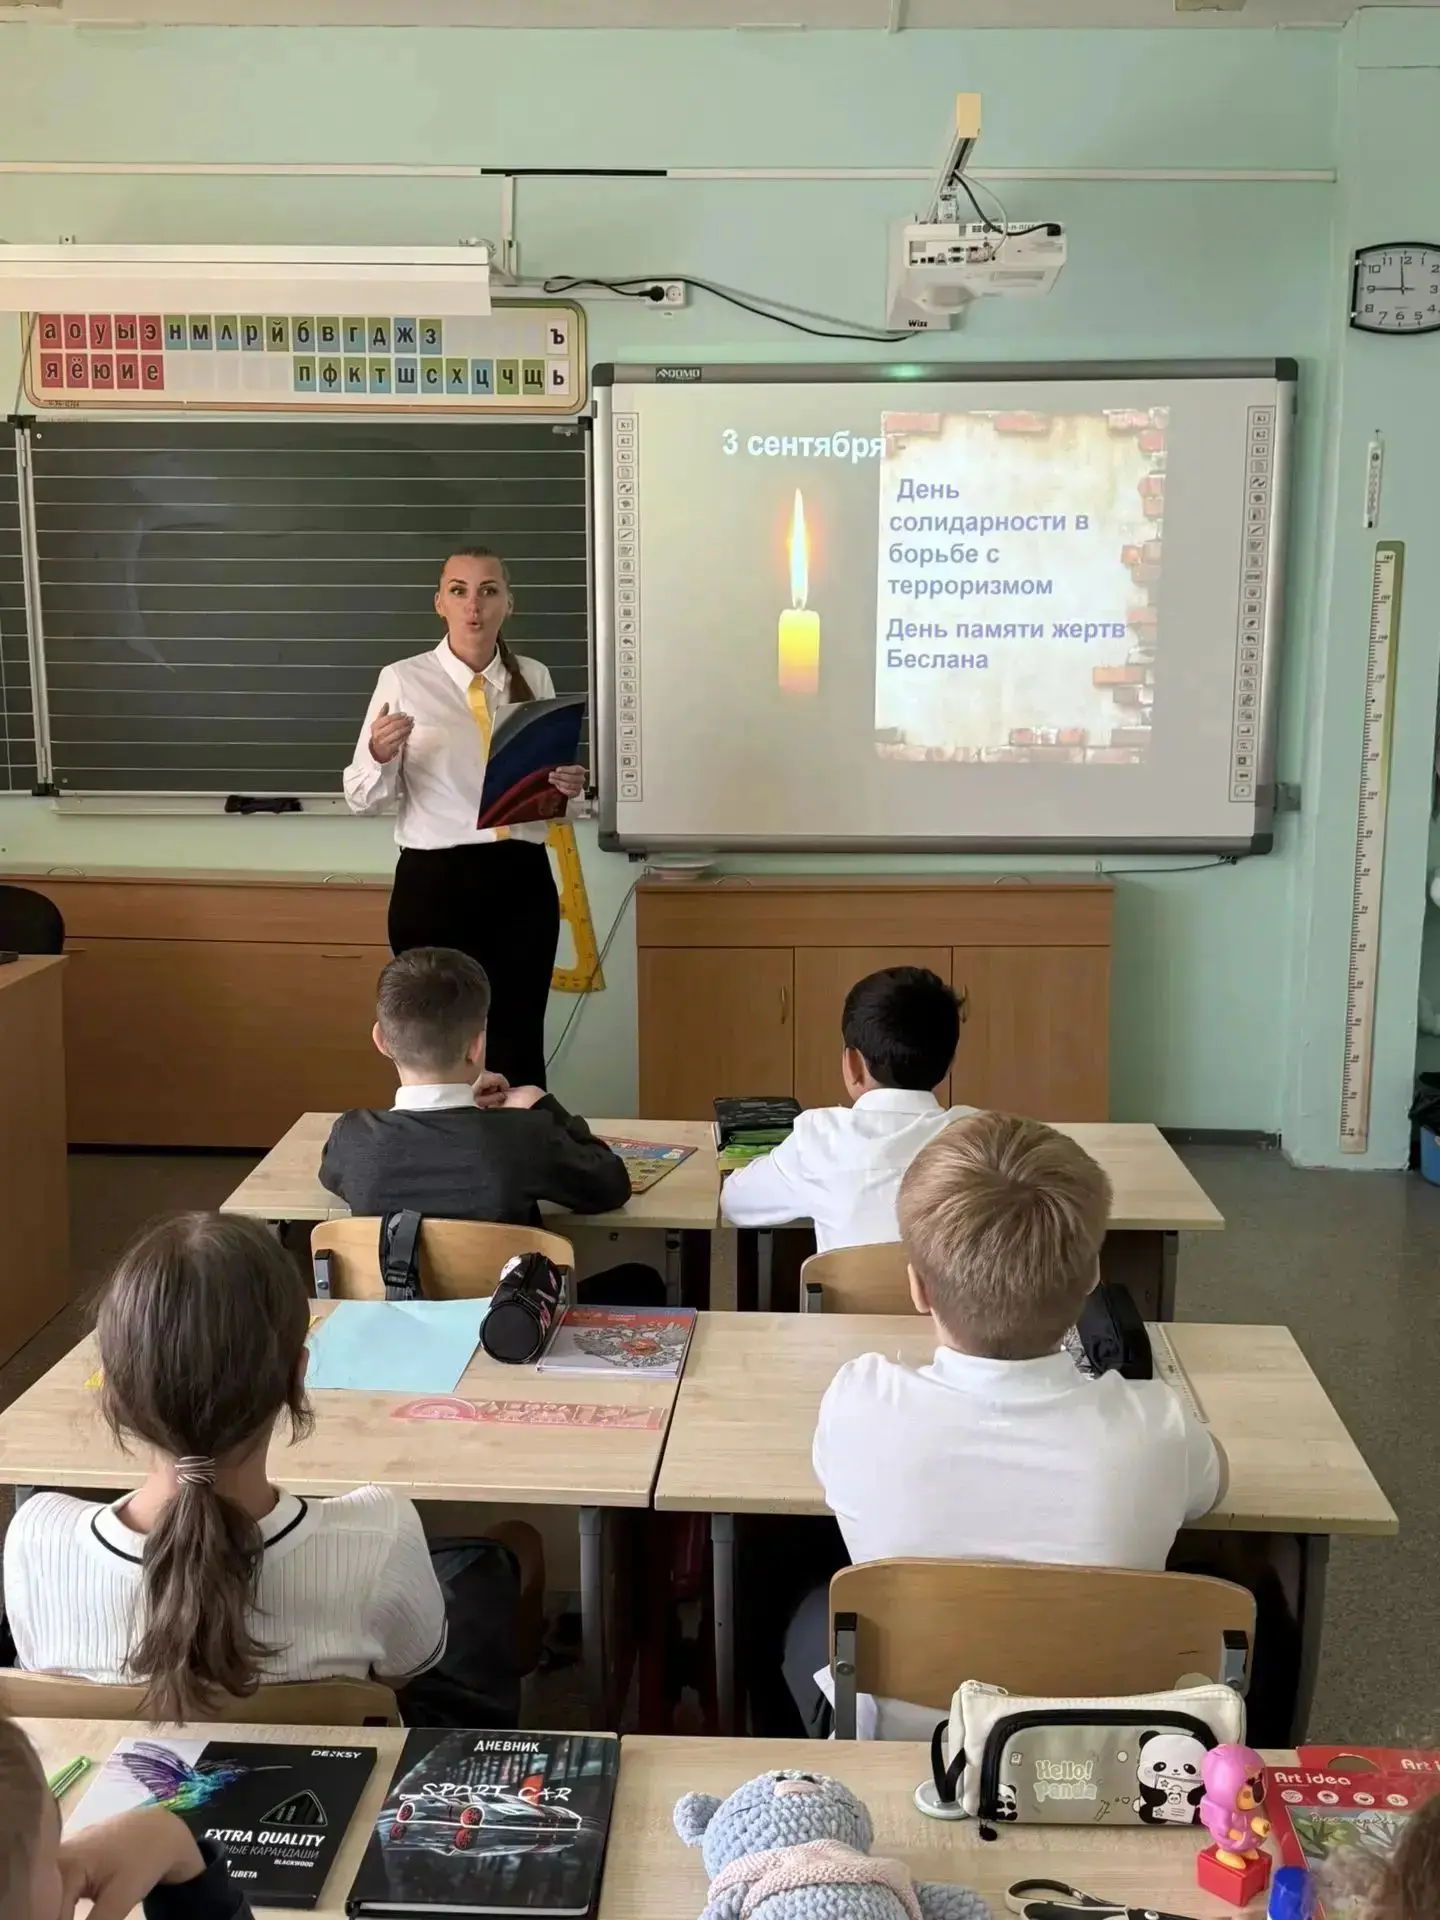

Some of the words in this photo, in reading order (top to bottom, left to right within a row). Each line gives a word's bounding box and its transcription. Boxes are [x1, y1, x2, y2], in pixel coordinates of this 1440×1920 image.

[1368, 264, 1381, 274] 10
[1431, 264, 1440, 274] 2
[1366, 285, 1376, 294] 9
[1430, 285, 1438, 294] 3
[1364, 304, 1374, 313] 8
[1427, 304, 1436, 313] 4
[1396, 311, 1405, 320] 6
[1414, 311, 1423, 320] 5
[44, 323, 56, 340] а
[69, 322, 81, 340] о
[95, 323, 106, 345] у
[118, 323, 135, 340] ы
[145, 323, 157, 341] э
[169, 324, 181, 340] н
[192, 324, 209, 340] м
[220, 324, 232, 340] л
[246, 324, 258, 346] р
[272, 319, 284, 343] й
[297, 320, 310, 343] б
[322, 326, 335, 342] в
[349, 326, 358, 342] г
[373, 326, 386, 346] д
[396, 326, 413, 343] ж
[425, 328, 436, 345] з
[550, 328, 565, 345] ъ
[46, 362, 58, 379] я
[71, 357, 83, 379] ё
[93, 363, 111, 380] ю
[122, 363, 134, 380] и
[147, 364, 158, 381] е
[299, 366, 310, 382] п
[322, 362, 338, 388] ф
[349, 366, 361, 383] к
[375, 367, 386, 383] т
[398, 367, 415, 384] ш
[426, 367, 438, 384] с
[451, 367, 463, 384] х
[476, 369, 489, 388] ц
[502, 369, 513, 384] ч
[524, 369, 543, 388] щ
[553, 369, 565, 386] ь
[722, 428, 739, 456] 3
[747, 430, 887, 464] сентября
[896, 478, 960, 503] День
[889, 514, 1067, 536] солидарности
[1075, 514, 1089, 530] в
[888, 543, 978, 568] борьбе
[986, 547, 1000, 564] с
[887, 578, 1053, 600] терроризмом
[886, 618, 948, 641] День
[956, 622, 1044, 639] памяти
[1052, 622, 1126, 643] жертв
[887, 649, 989, 669] Беслана
[473, 1740, 540, 1753] ДНЕВНИК
[1035, 1759, 1094, 1780] Hello!
[1401, 1758, 1432, 1771] Art
[1274, 1772, 1305, 1784] Art
[1307, 1773, 1351, 1786] idea
[421, 1783, 510, 1799] SPORT
[518, 1786, 573, 1802] CAR
[258, 1831, 325, 1847] QUALITY
[250, 1845, 320, 1860] КАРАНДАШИ
[230, 1870, 258, 1878] ЦВЕТА
